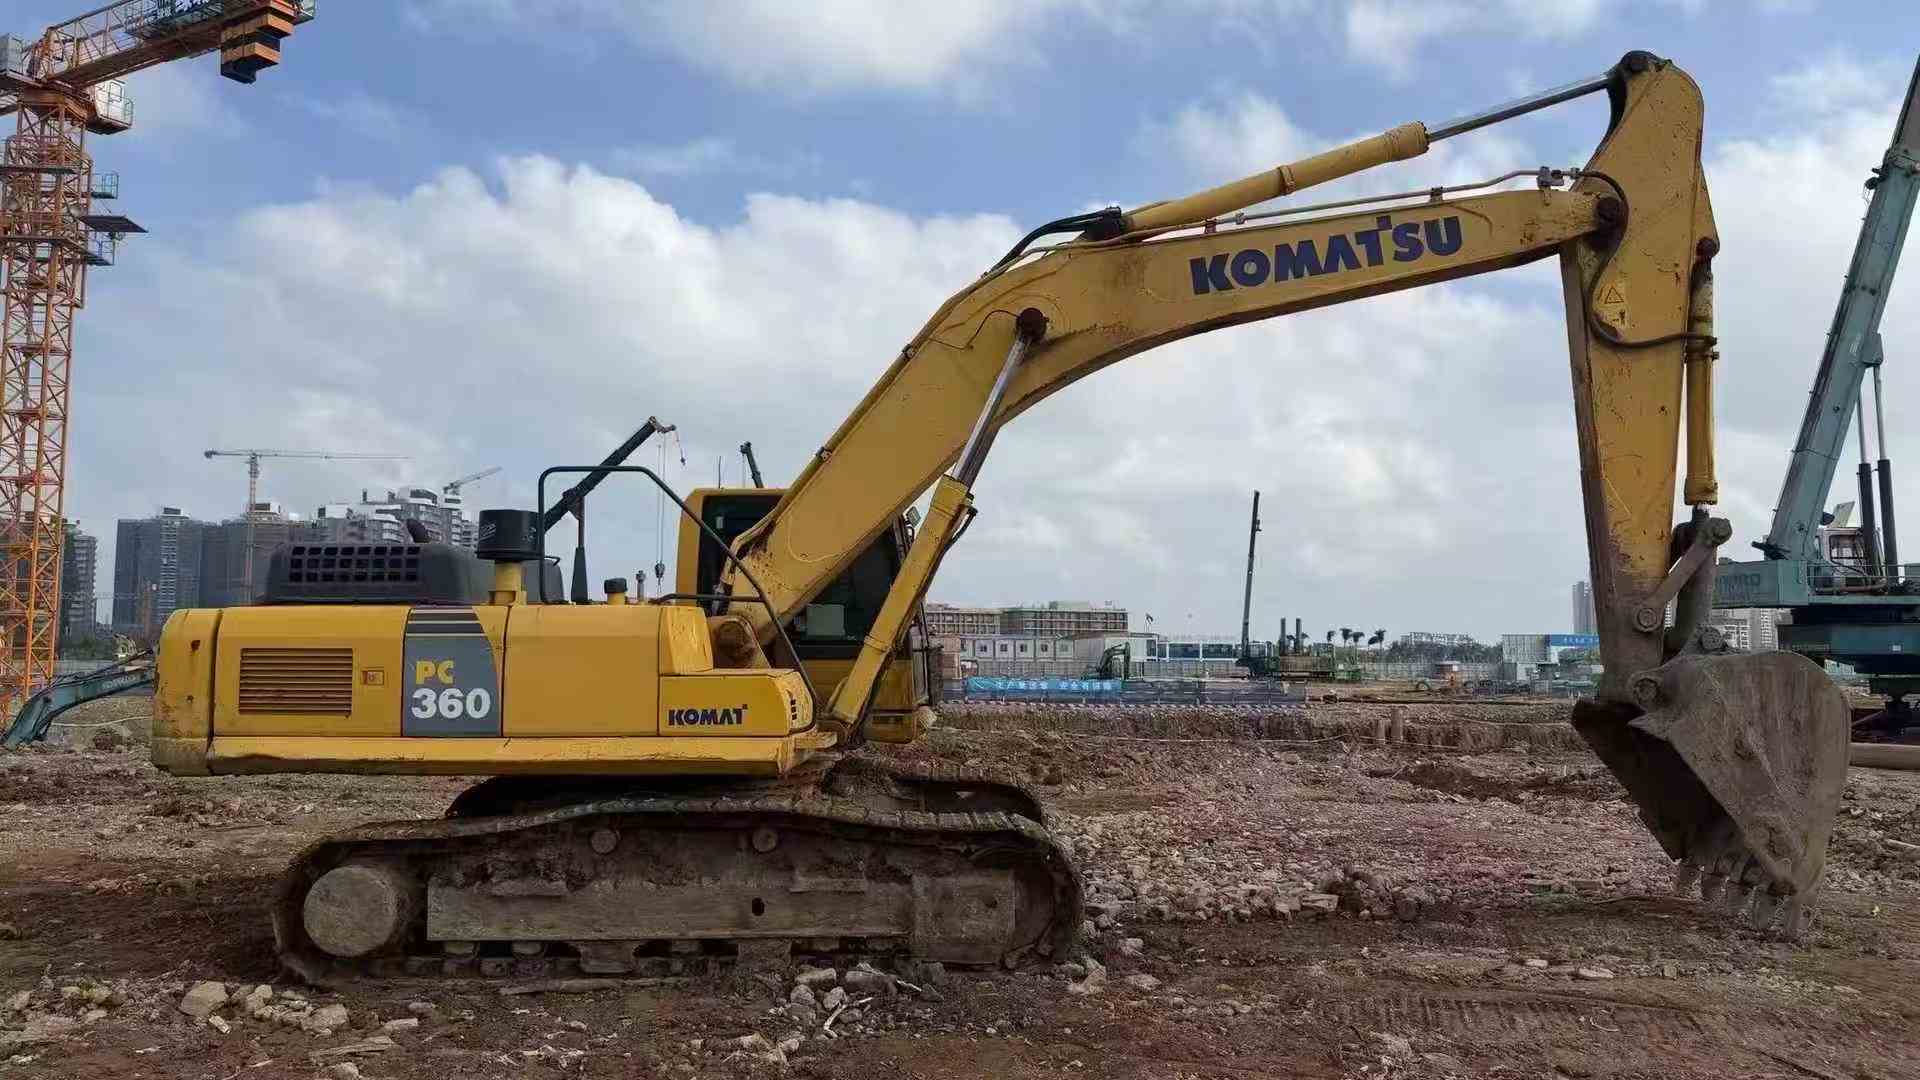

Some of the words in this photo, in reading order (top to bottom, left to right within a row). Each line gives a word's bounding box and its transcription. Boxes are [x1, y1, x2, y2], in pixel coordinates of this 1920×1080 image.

[1189, 216, 1463, 295] KOMATSU
[415, 660, 455, 685] PC
[411, 687, 491, 719] 360
[668, 704, 748, 726] KOMAT
